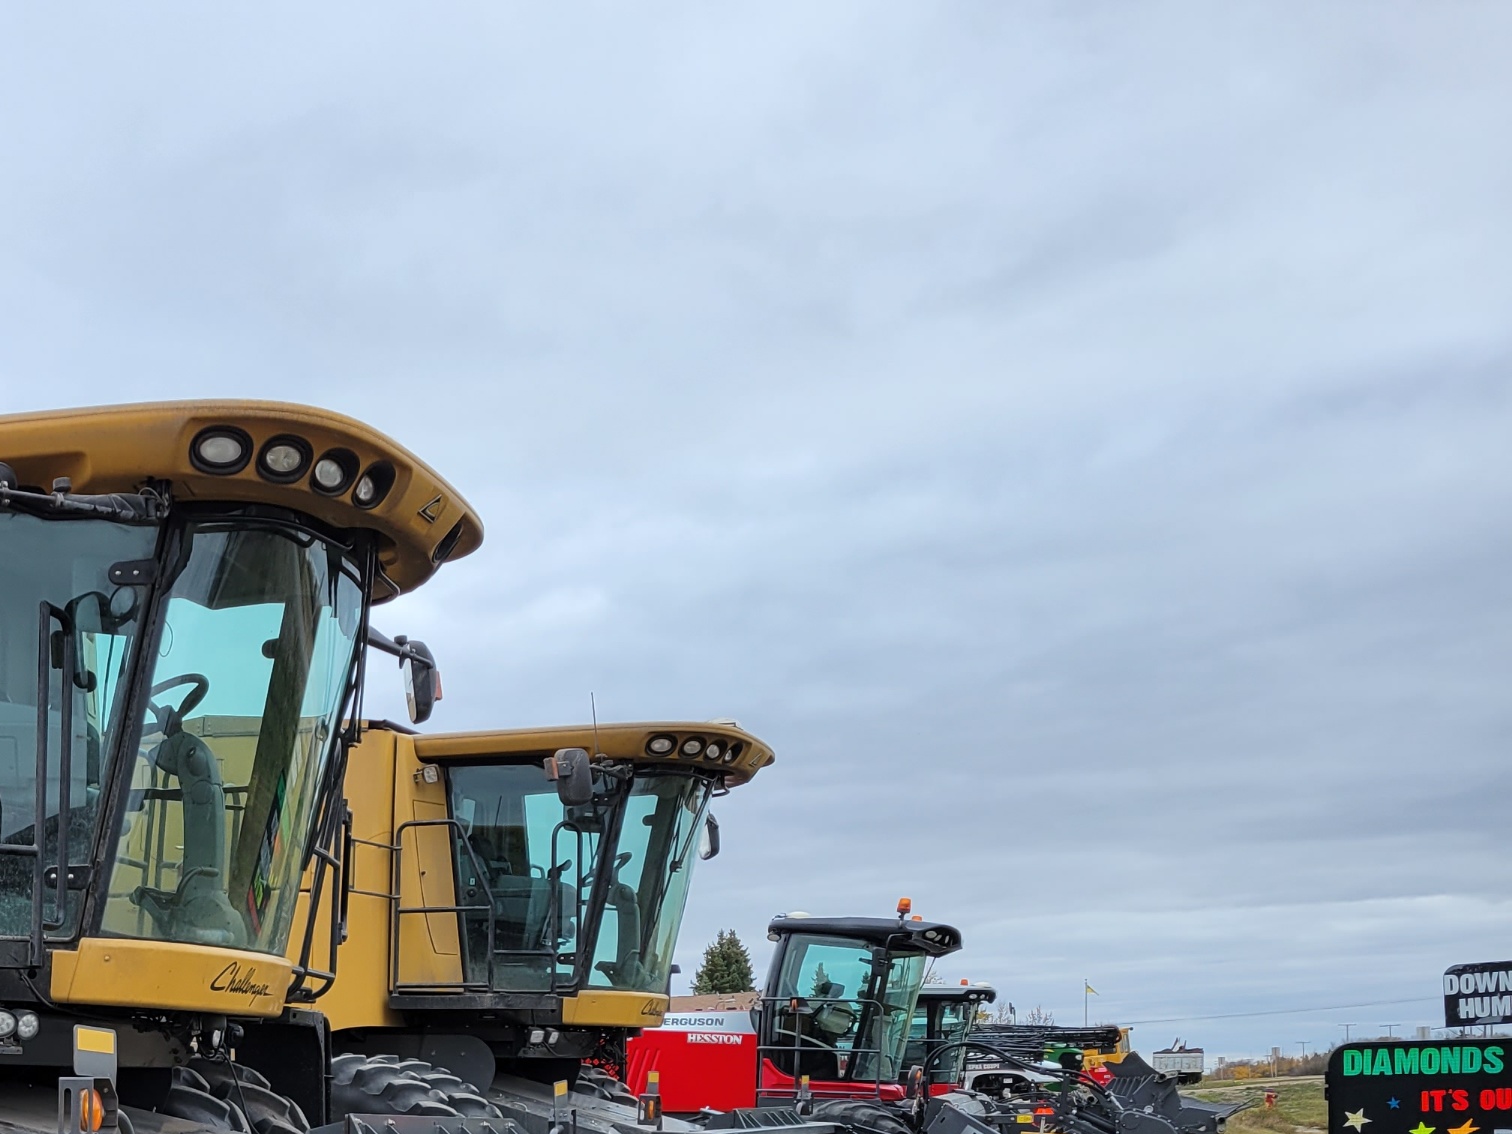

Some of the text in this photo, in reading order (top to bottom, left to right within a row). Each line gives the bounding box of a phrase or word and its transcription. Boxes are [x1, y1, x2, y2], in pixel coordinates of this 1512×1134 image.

[210, 961, 274, 1007] Challenger
[662, 1018, 724, 1026] ERGUSON
[687, 1033, 743, 1045] HESSTON
[1343, 1046, 1504, 1076] DIAMONDS
[1421, 1089, 1469, 1112] IT'S
